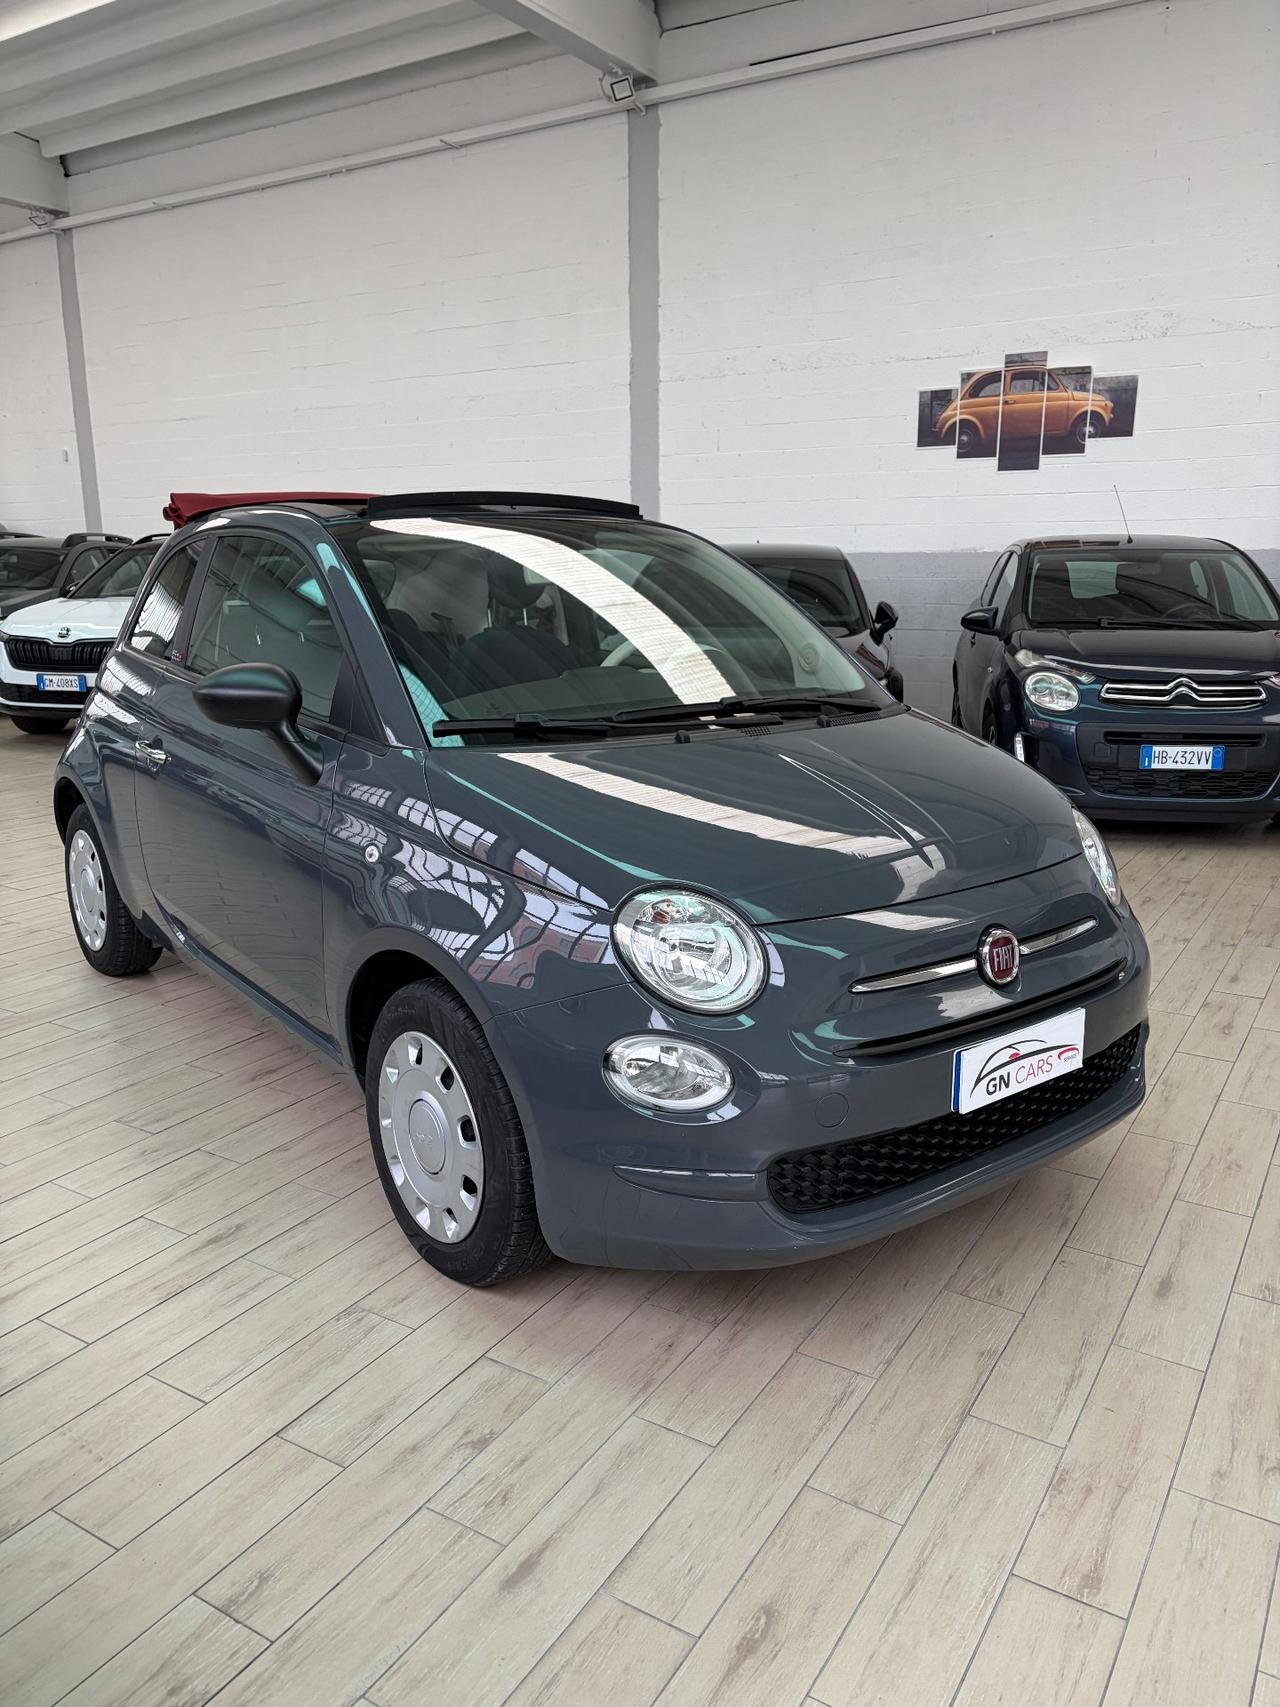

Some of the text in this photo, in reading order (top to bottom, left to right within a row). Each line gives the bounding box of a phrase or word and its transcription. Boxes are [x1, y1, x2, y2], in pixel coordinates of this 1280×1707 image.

[992, 943, 1013, 971] FIAT
[985, 1055, 1053, 1096] GN CARS
